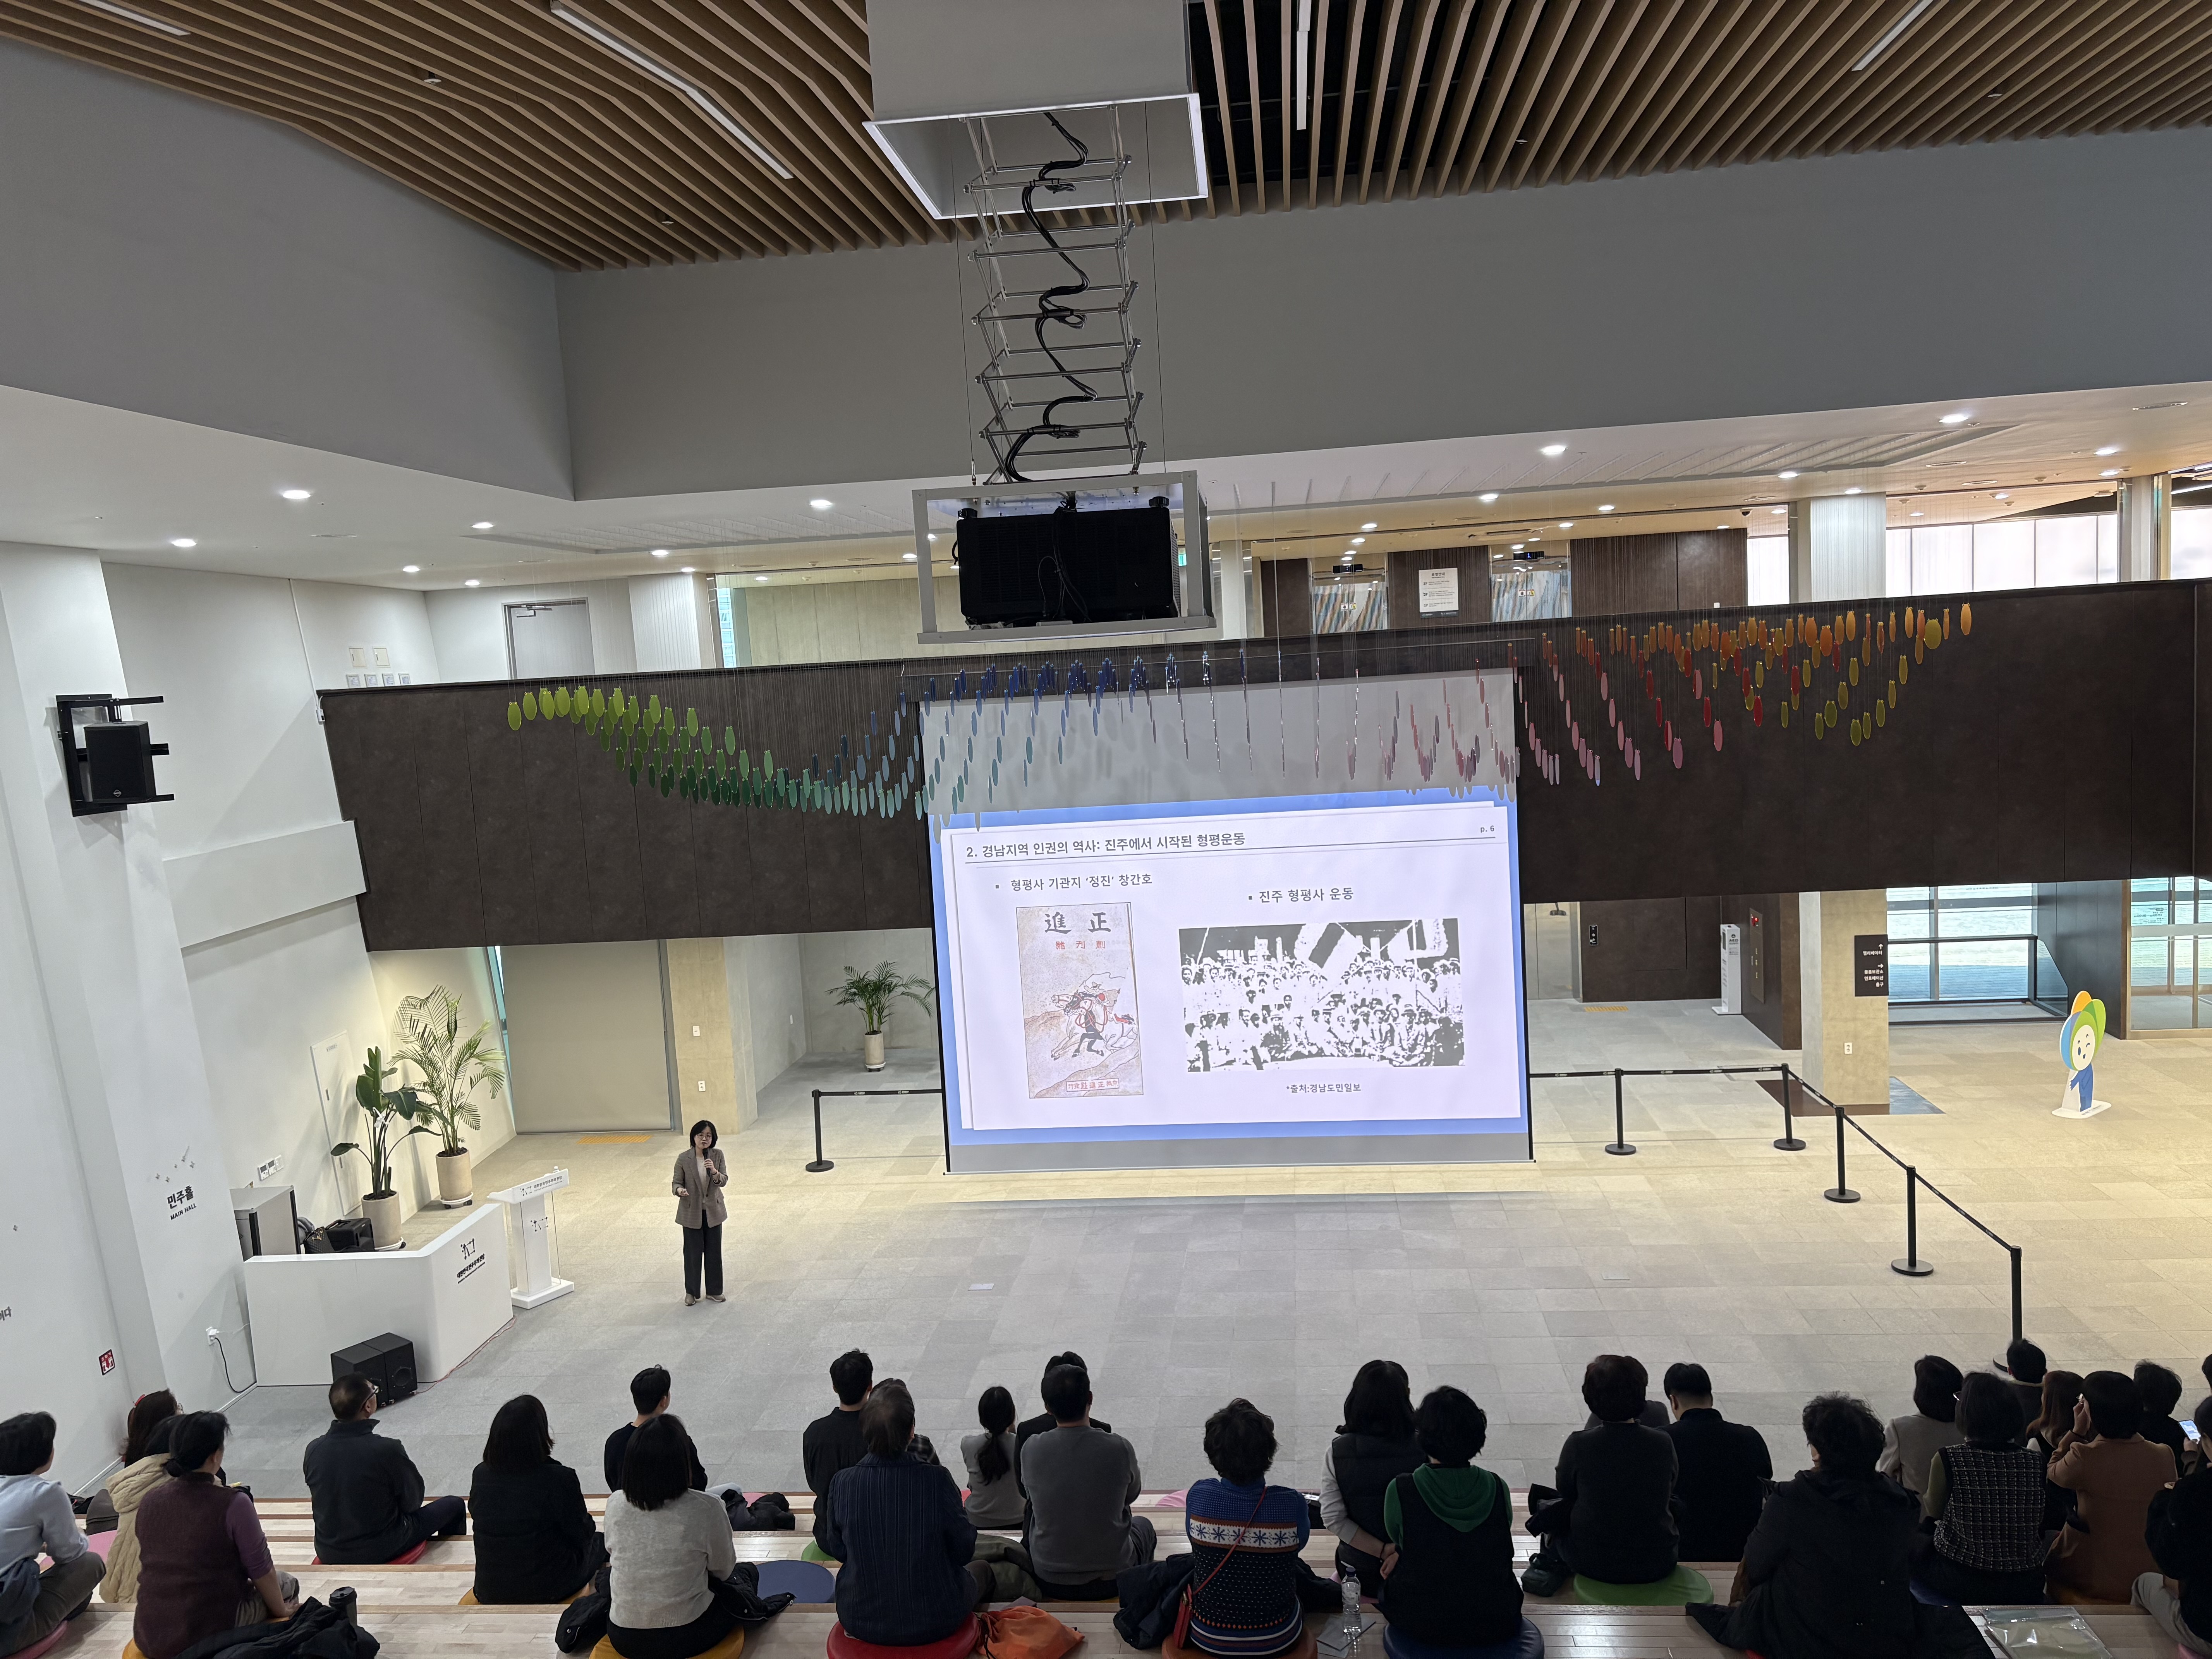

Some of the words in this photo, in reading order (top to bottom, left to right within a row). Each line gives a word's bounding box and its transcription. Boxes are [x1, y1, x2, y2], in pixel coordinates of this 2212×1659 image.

[967, 847, 977, 857] 2.
[982, 843, 1029, 858] 경남지역
[1033, 842, 1068, 855] 인권의
[1073, 840, 1100, 853] 역사:
[1105, 837, 1152, 851] 진주에서
[1157, 835, 1192, 848] 시작된
[1197, 833, 1245, 847] 형평운동
[1010, 878, 1044, 891] 형평사
[1049, 876, 1081, 890] 기관지
[1118, 873, 1152, 886] 창간호
[1259, 890, 1283, 903] 진주
[1288, 888, 1324, 902] 형평사
[1329, 888, 1353, 900] 운동
[167, 1185, 194, 1209] 민주홀
[170, 1210, 183, 1220] MAIN
[184, 1203, 197, 1213] HALL
